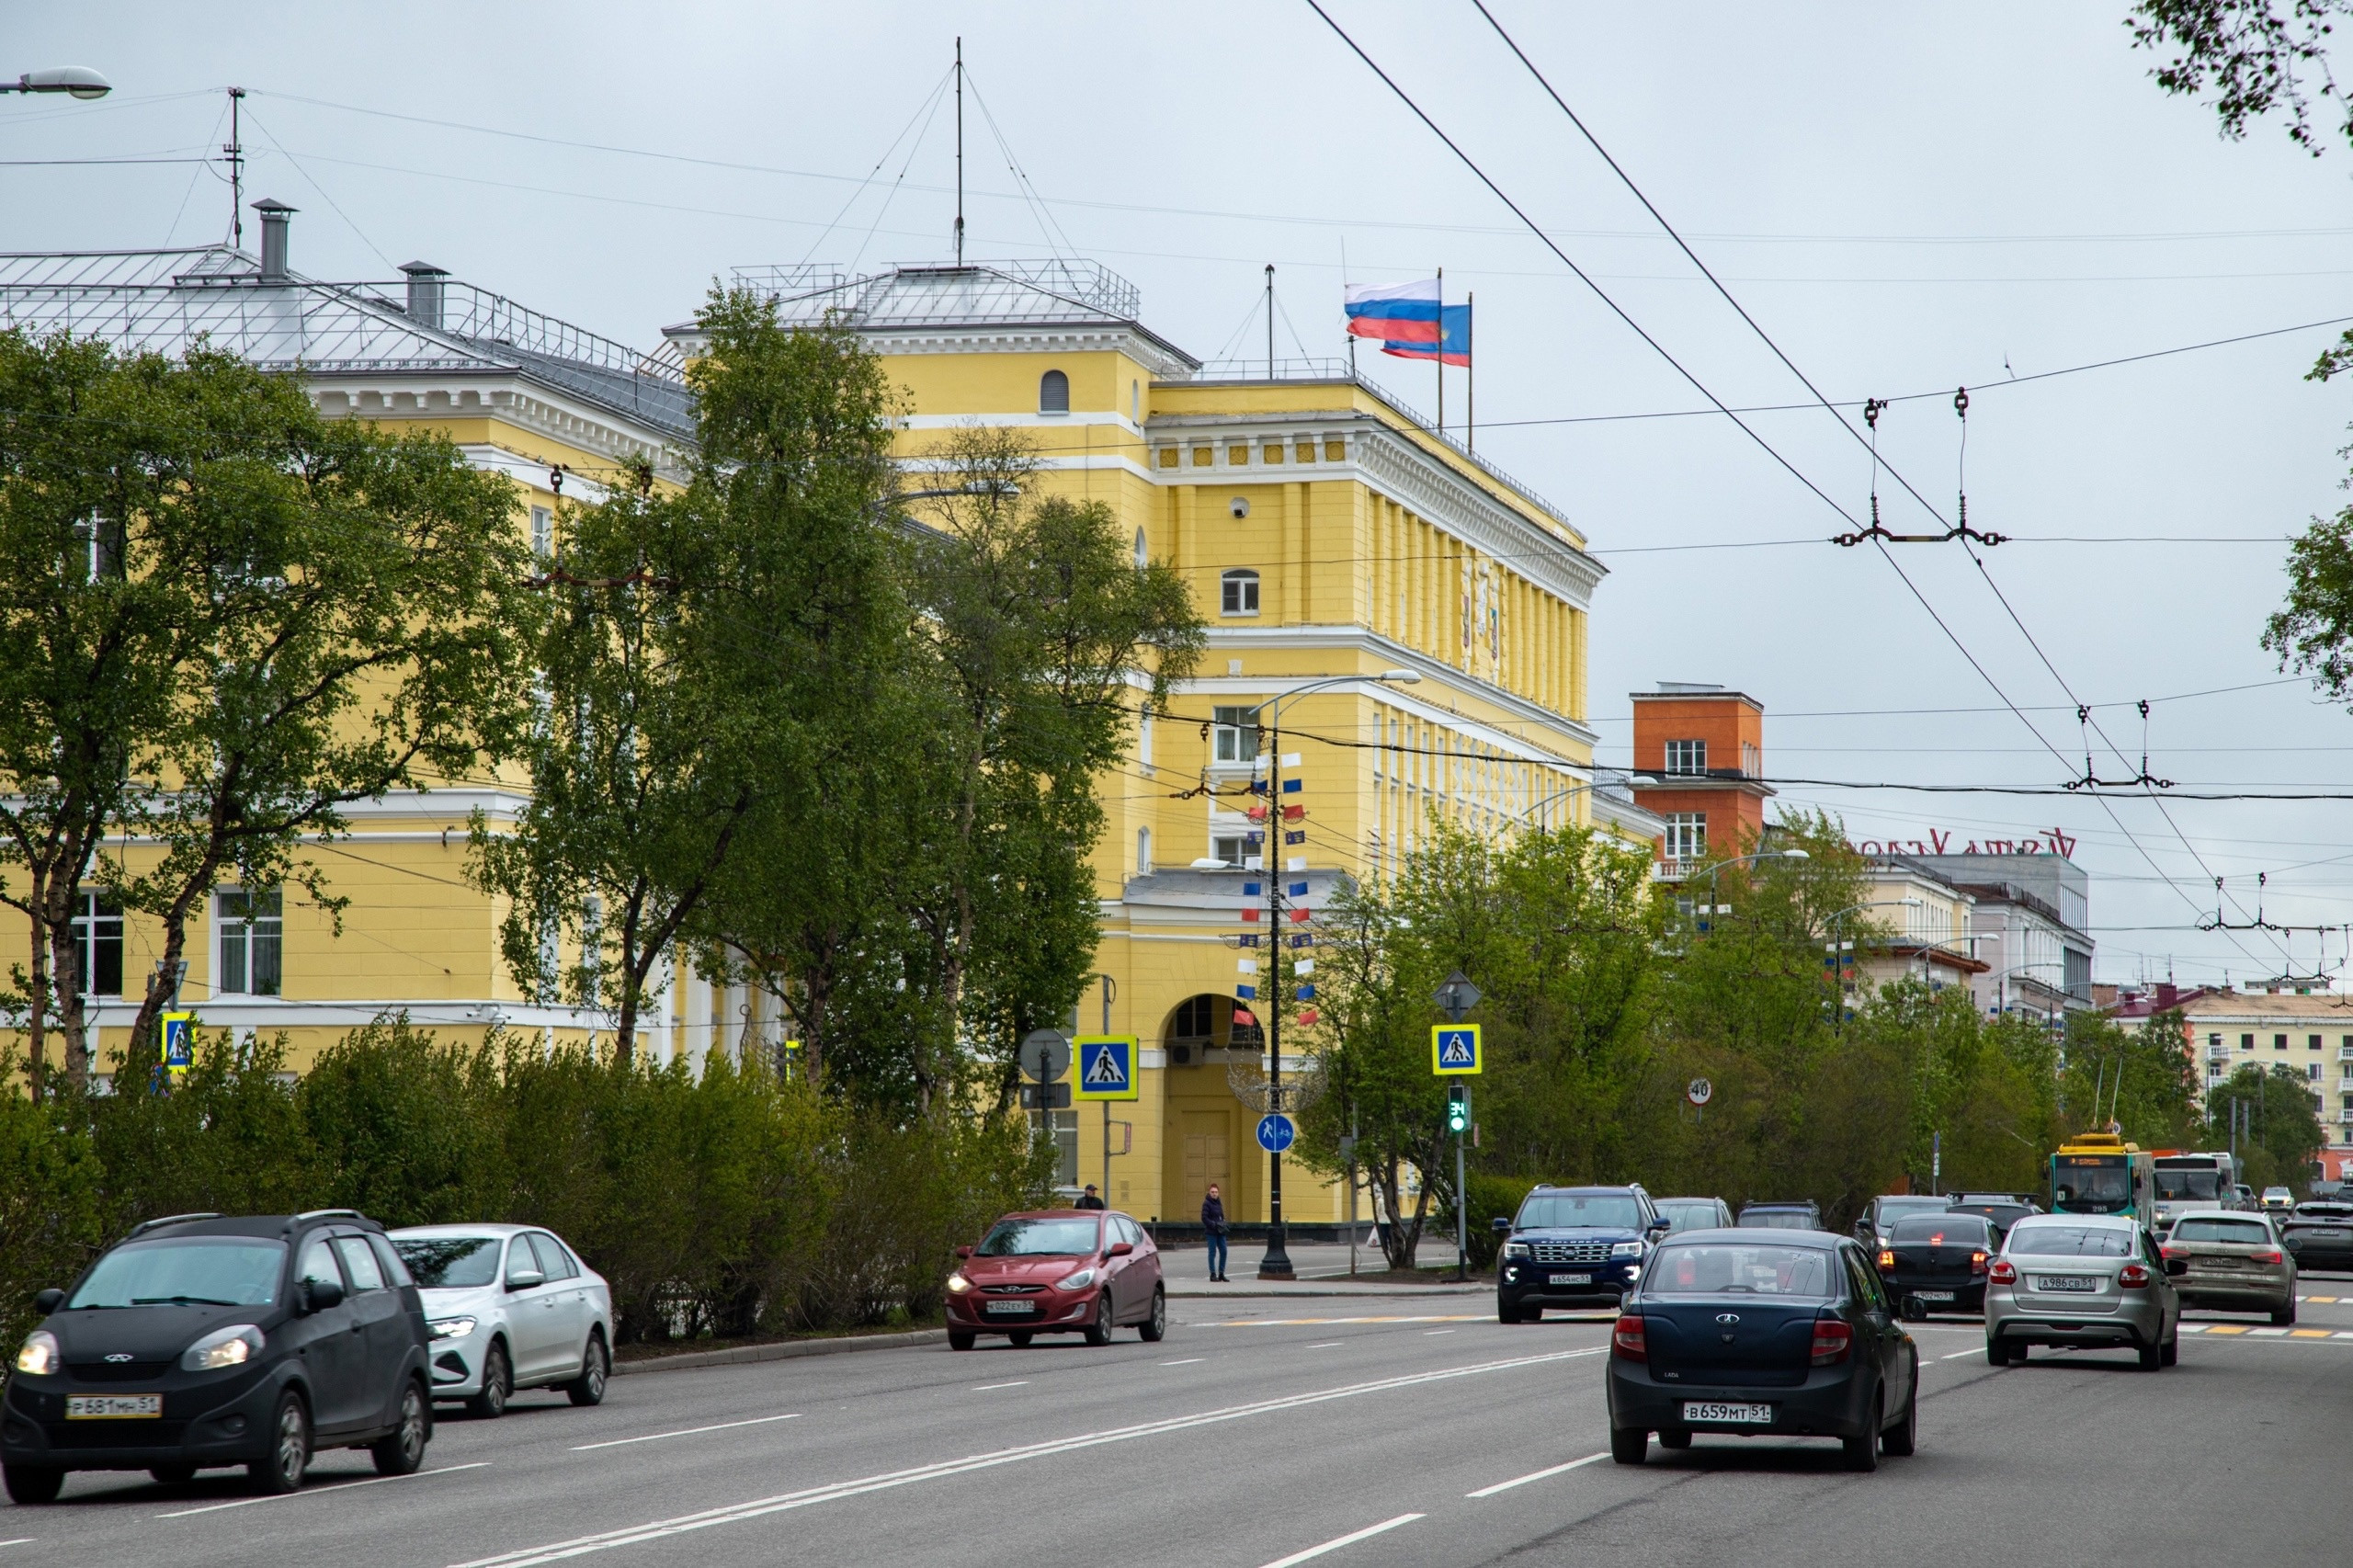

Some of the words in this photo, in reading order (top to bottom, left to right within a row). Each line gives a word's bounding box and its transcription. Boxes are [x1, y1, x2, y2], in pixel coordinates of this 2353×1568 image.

[1691, 1083, 1708, 1096] 40
[1450, 1102, 1465, 1116] 34
[1750, 1404, 1766, 1416] 51
